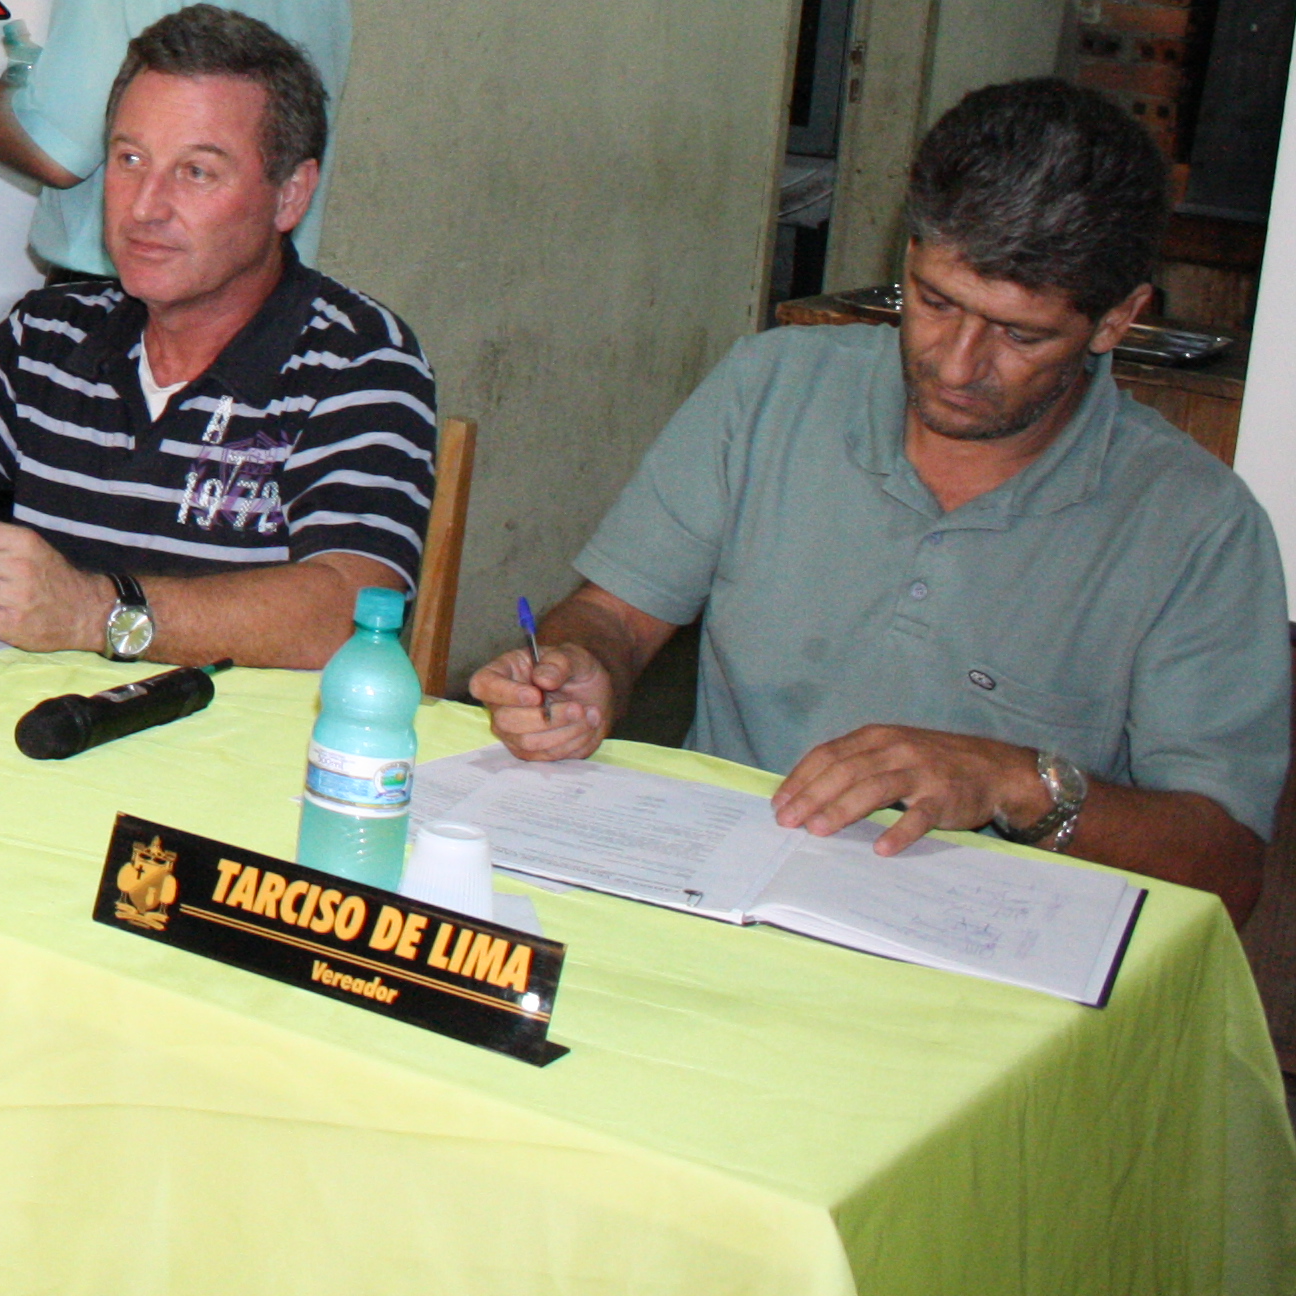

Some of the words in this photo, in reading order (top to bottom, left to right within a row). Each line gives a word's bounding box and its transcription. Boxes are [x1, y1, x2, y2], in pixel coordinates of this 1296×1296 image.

[211, 857, 366, 943] TARCISO
[368, 905, 431, 961] DE
[426, 923, 533, 994] LIMA
[311, 960, 398, 1005] Vereador
